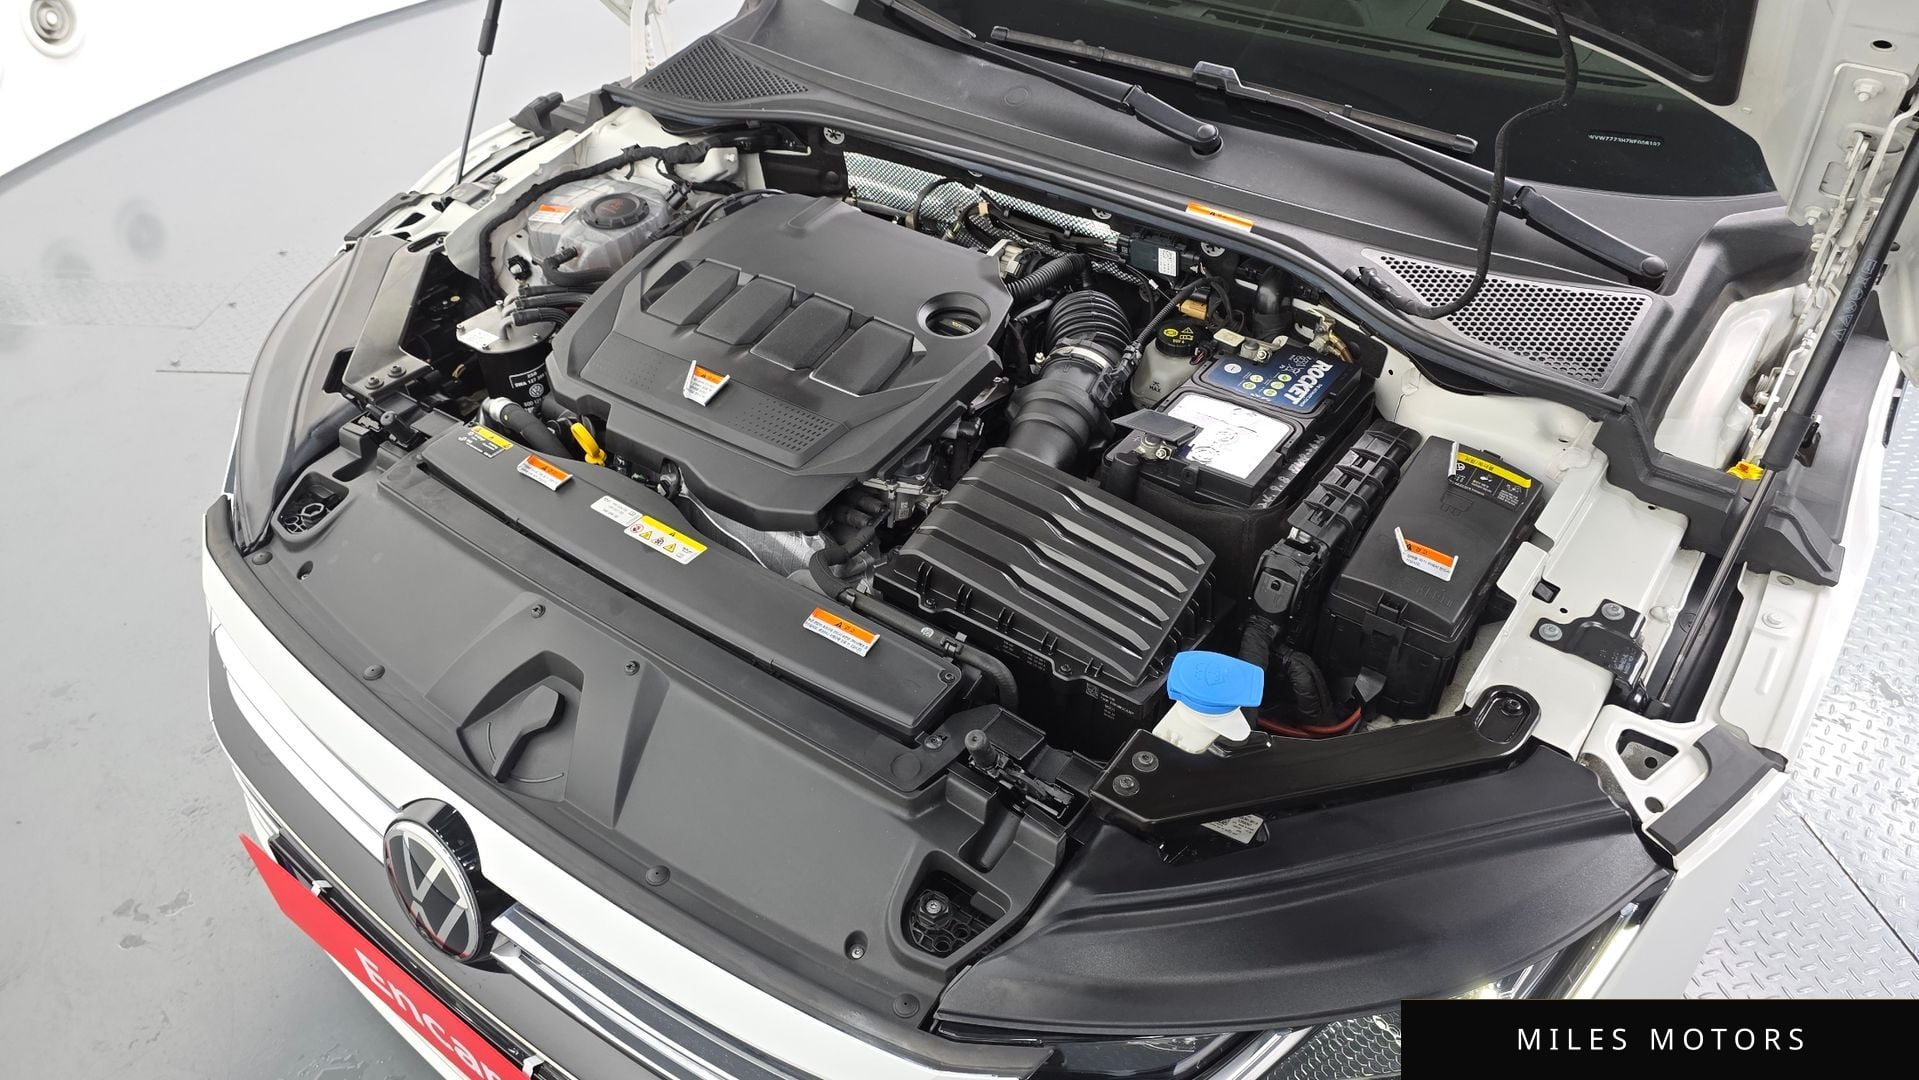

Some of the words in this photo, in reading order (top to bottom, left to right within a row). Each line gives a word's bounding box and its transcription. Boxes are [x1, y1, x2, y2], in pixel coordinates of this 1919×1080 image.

[1149, 385, 1161, 393] MAX
[1283, 359, 1334, 406] ROCKET
[354, 946, 503, 1080] Encar
